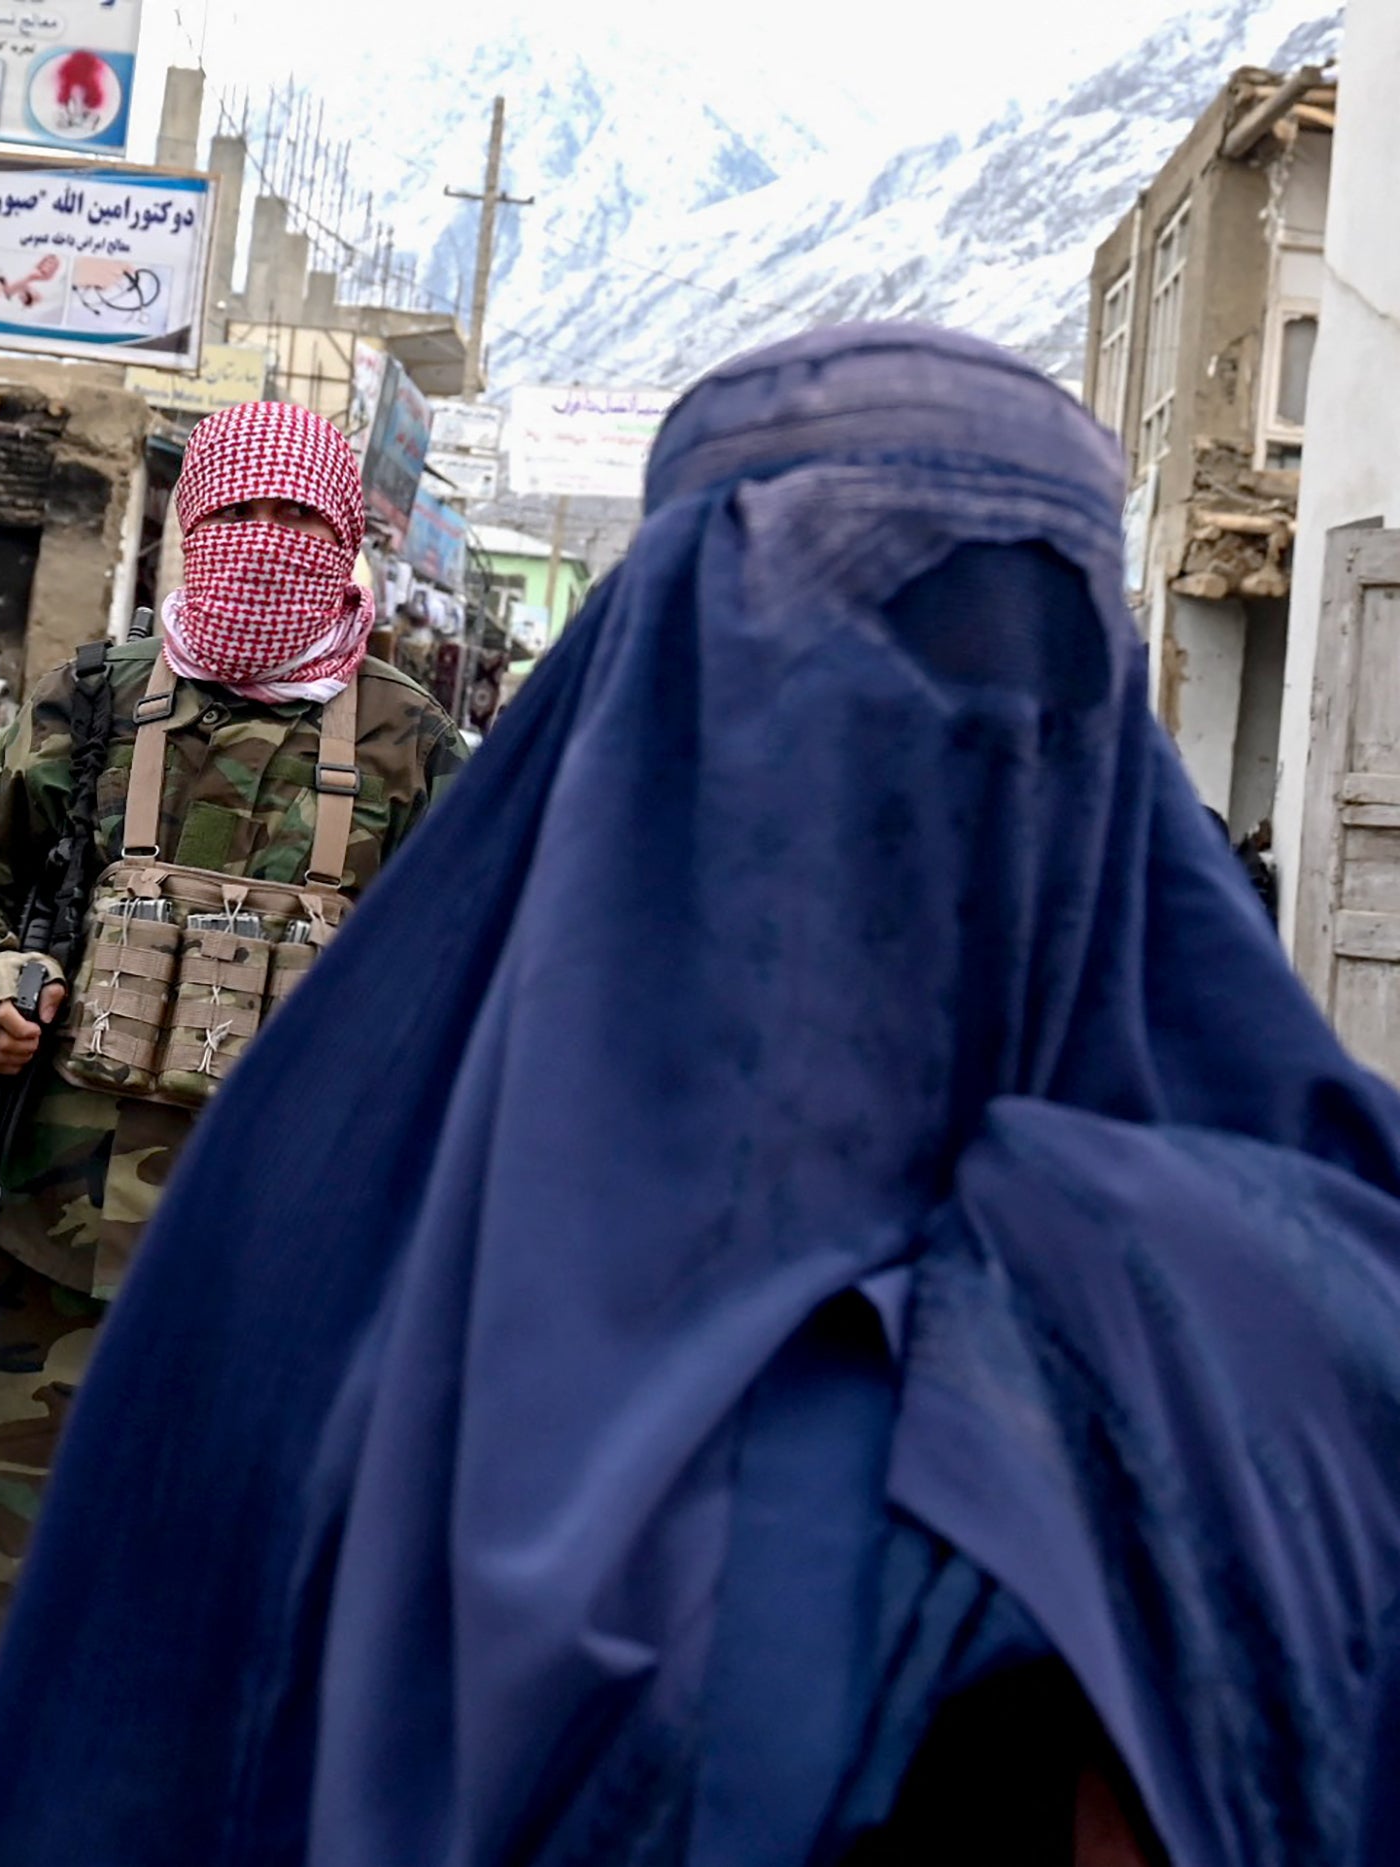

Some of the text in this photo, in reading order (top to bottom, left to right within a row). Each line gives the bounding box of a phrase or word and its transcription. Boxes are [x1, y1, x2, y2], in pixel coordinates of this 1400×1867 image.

[19, 14, 58, 36] معالج
[52, 183, 84, 214] الله
[106, 238, 131, 255] معالج
